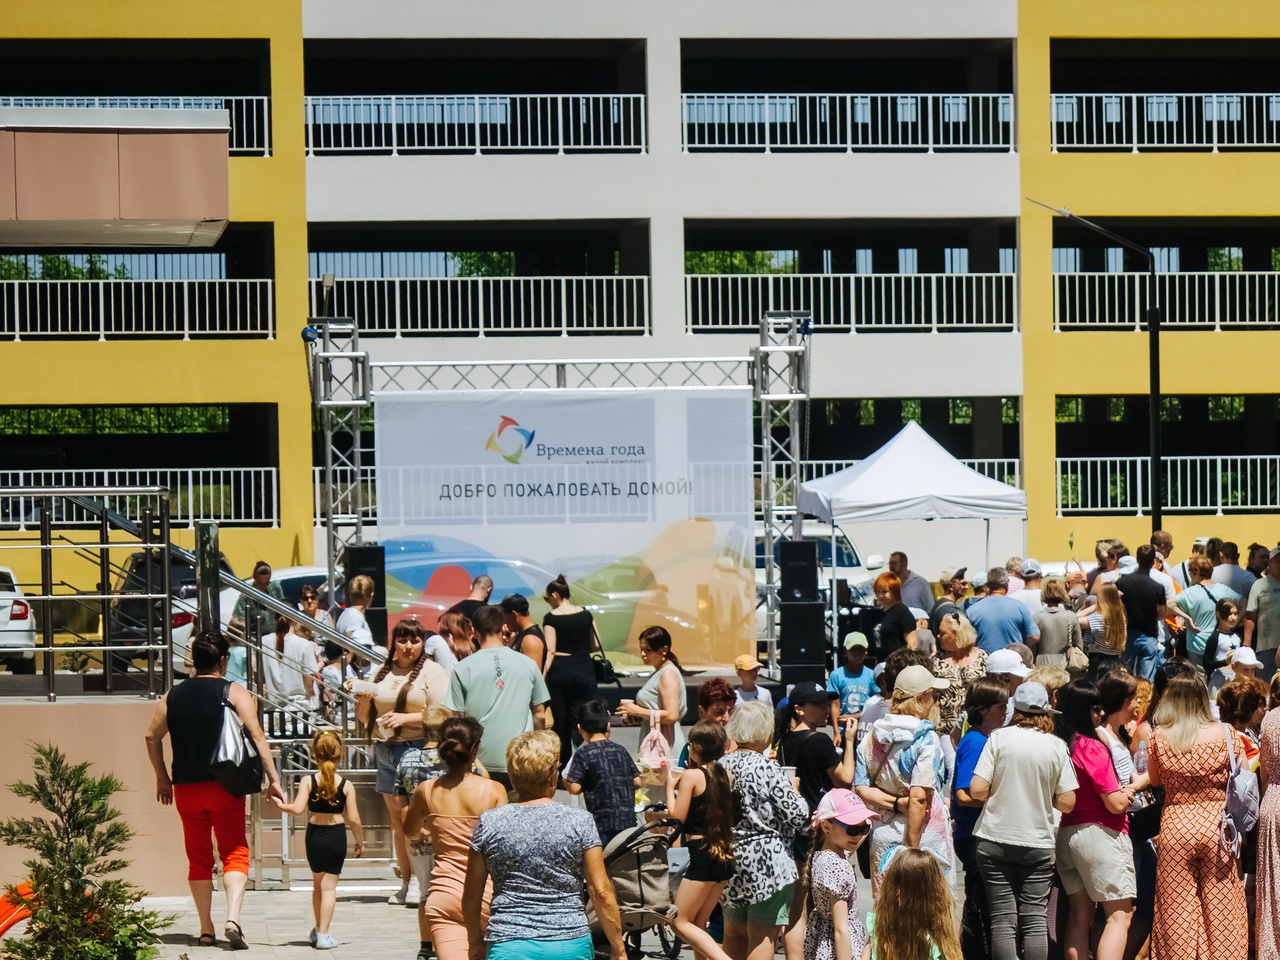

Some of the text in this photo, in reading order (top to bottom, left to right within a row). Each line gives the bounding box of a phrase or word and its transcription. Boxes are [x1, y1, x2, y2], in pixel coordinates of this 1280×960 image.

[536, 443, 646, 460] Времена года
[439, 478, 694, 500] ДОБРО ПОЖАЛОВАТЬ ДОМОЙ!
